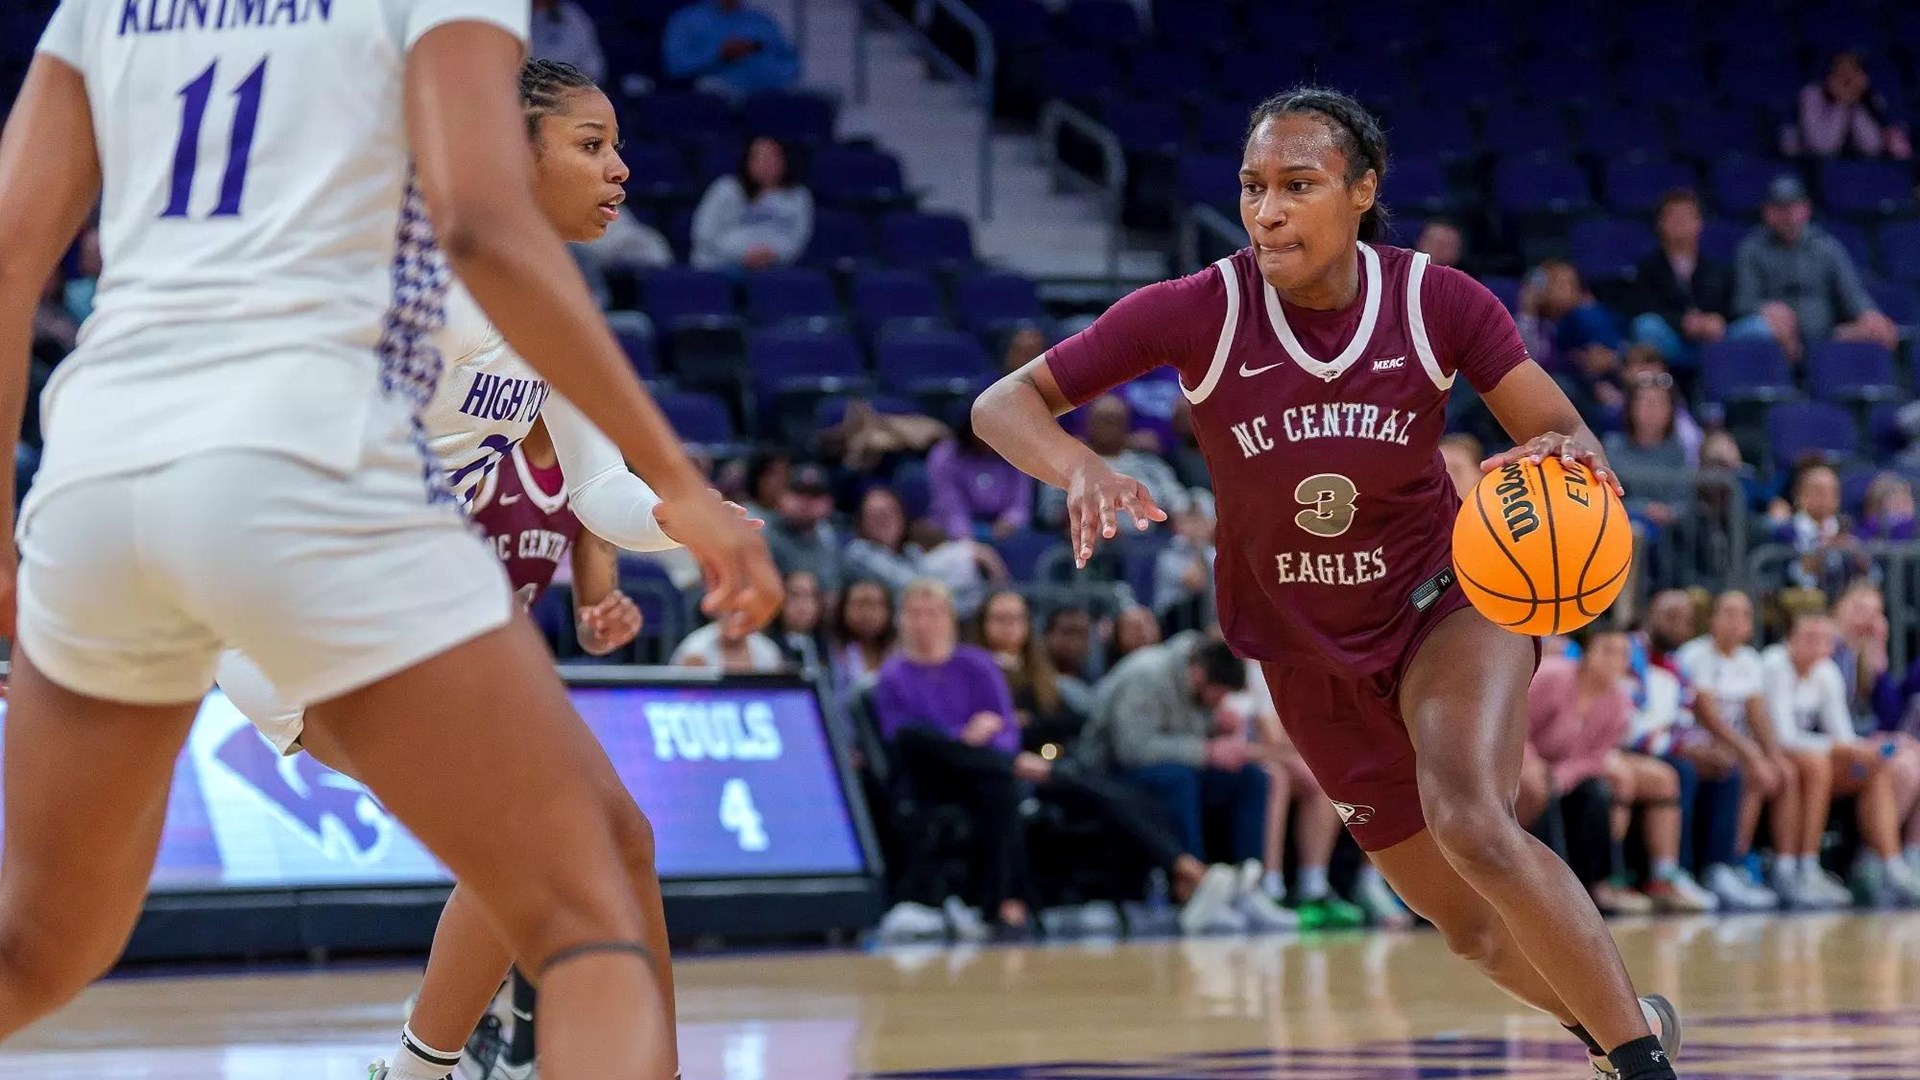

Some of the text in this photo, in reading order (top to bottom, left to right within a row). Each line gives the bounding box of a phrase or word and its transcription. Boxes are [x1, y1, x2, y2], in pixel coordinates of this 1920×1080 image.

[156, 56, 270, 219] 11
[1372, 356, 1405, 371] MEAC
[459, 372, 552, 422] HIGH PO
[1230, 402, 1417, 459] NC CENTRAL
[1294, 473, 1361, 538] 3
[1495, 462, 1540, 543] Wilso
[518, 529, 569, 563] CENTR
[1275, 546, 1387, 585] EAGLES
[1440, 575, 1450, 586] M
[643, 701, 784, 762] FOULS
[718, 778, 770, 852] 4
